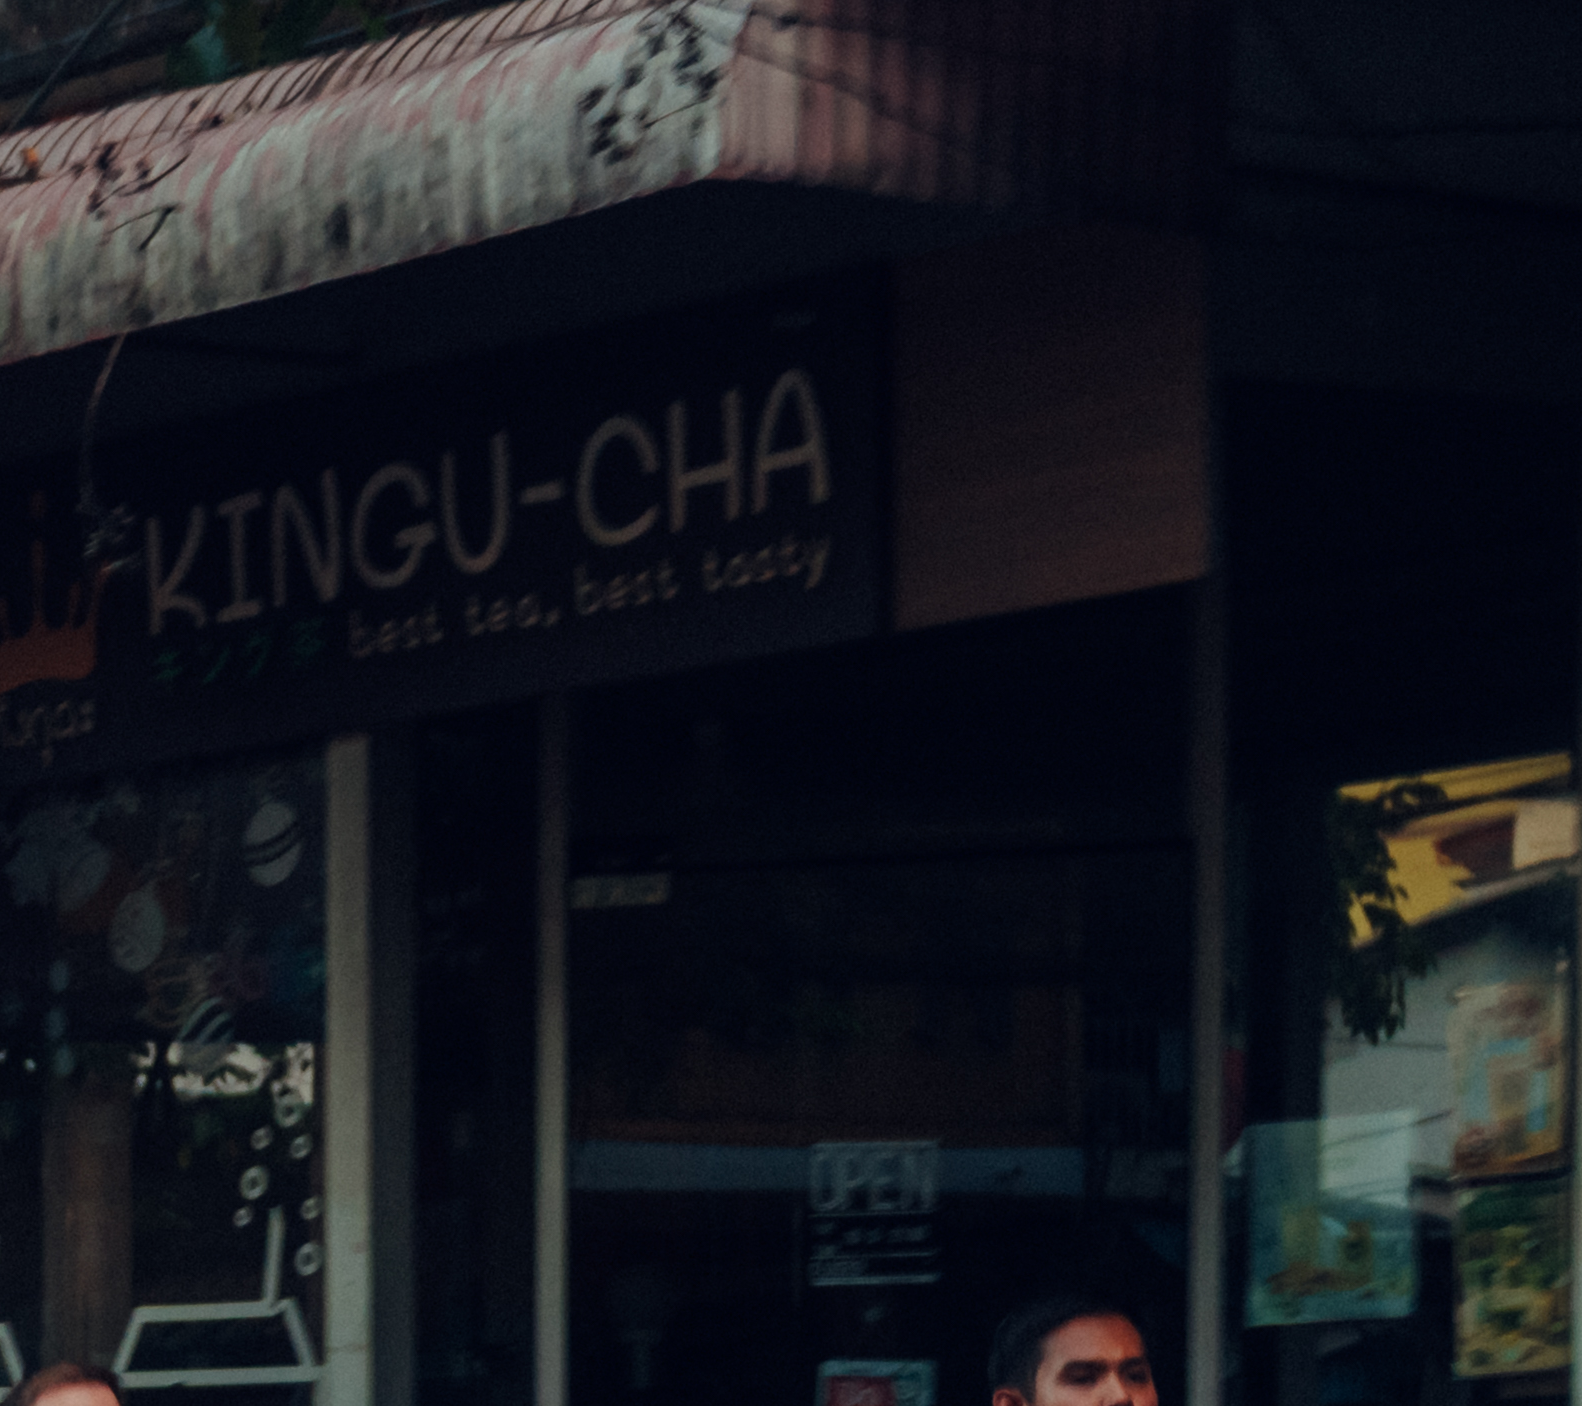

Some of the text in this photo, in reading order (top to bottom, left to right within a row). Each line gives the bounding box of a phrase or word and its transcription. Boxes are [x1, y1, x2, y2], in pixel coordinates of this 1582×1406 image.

[144, 368, 832, 636] KINGU-CHA
[348, 603, 444, 660] best
[573, 558, 680, 617] best
[702, 533, 832, 594] tasty
